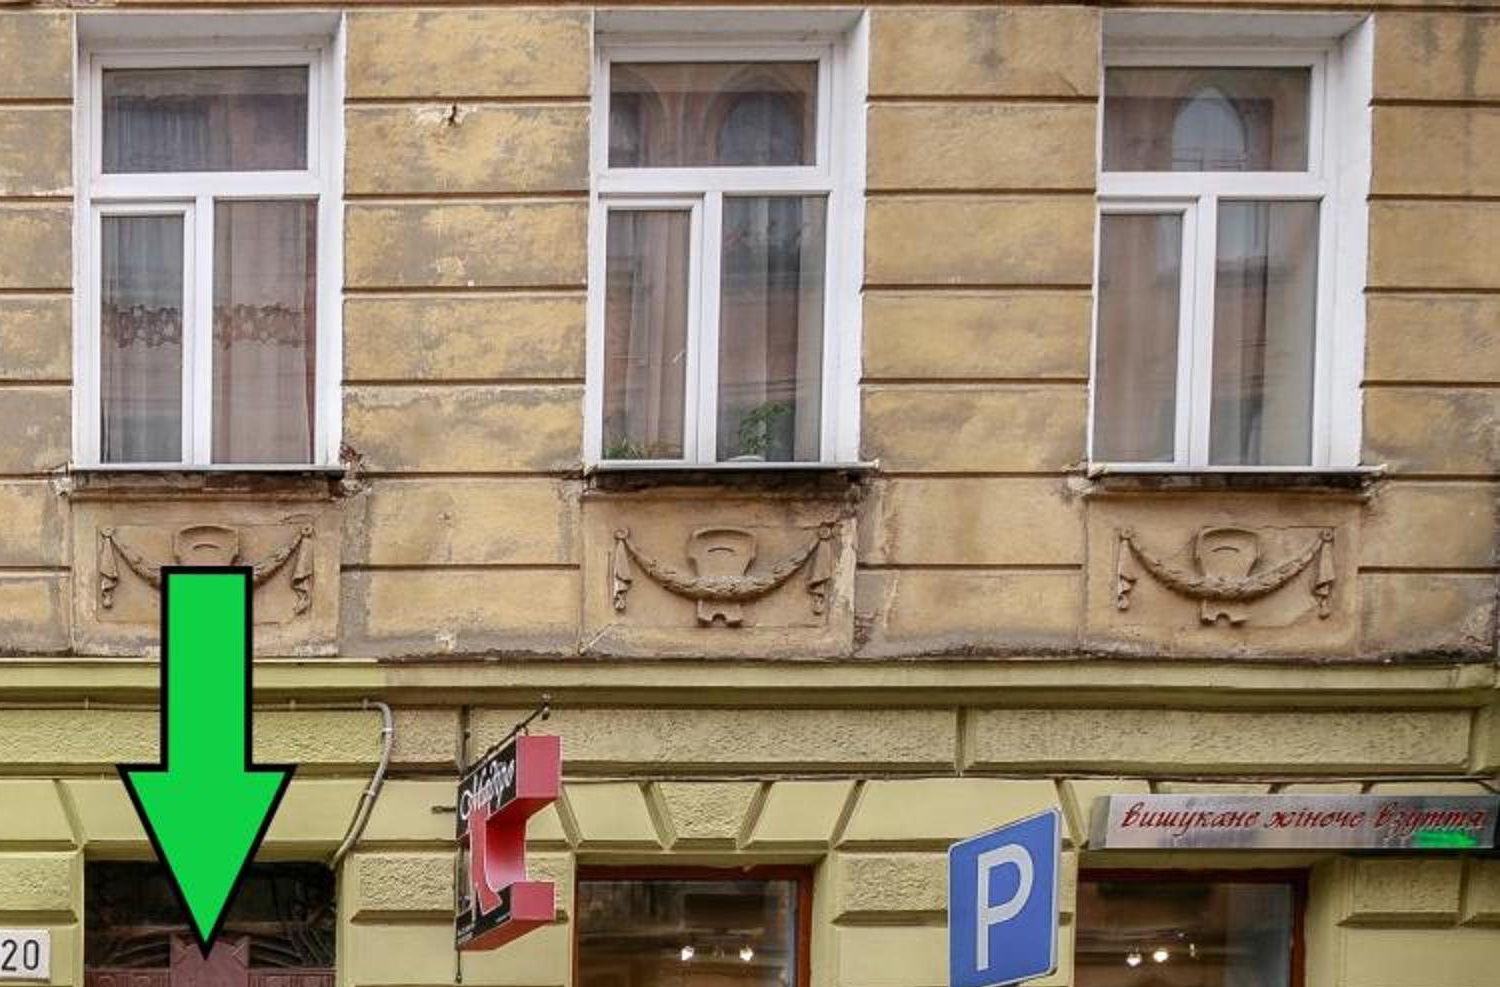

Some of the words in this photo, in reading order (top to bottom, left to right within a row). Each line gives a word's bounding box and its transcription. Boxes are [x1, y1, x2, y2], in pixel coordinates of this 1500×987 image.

[1121, 801, 1260, 837] вишукане
[1263, 807, 1365, 829] жіноче
[976, 843, 1034, 971] P
[1, 939, 40, 971] 20
